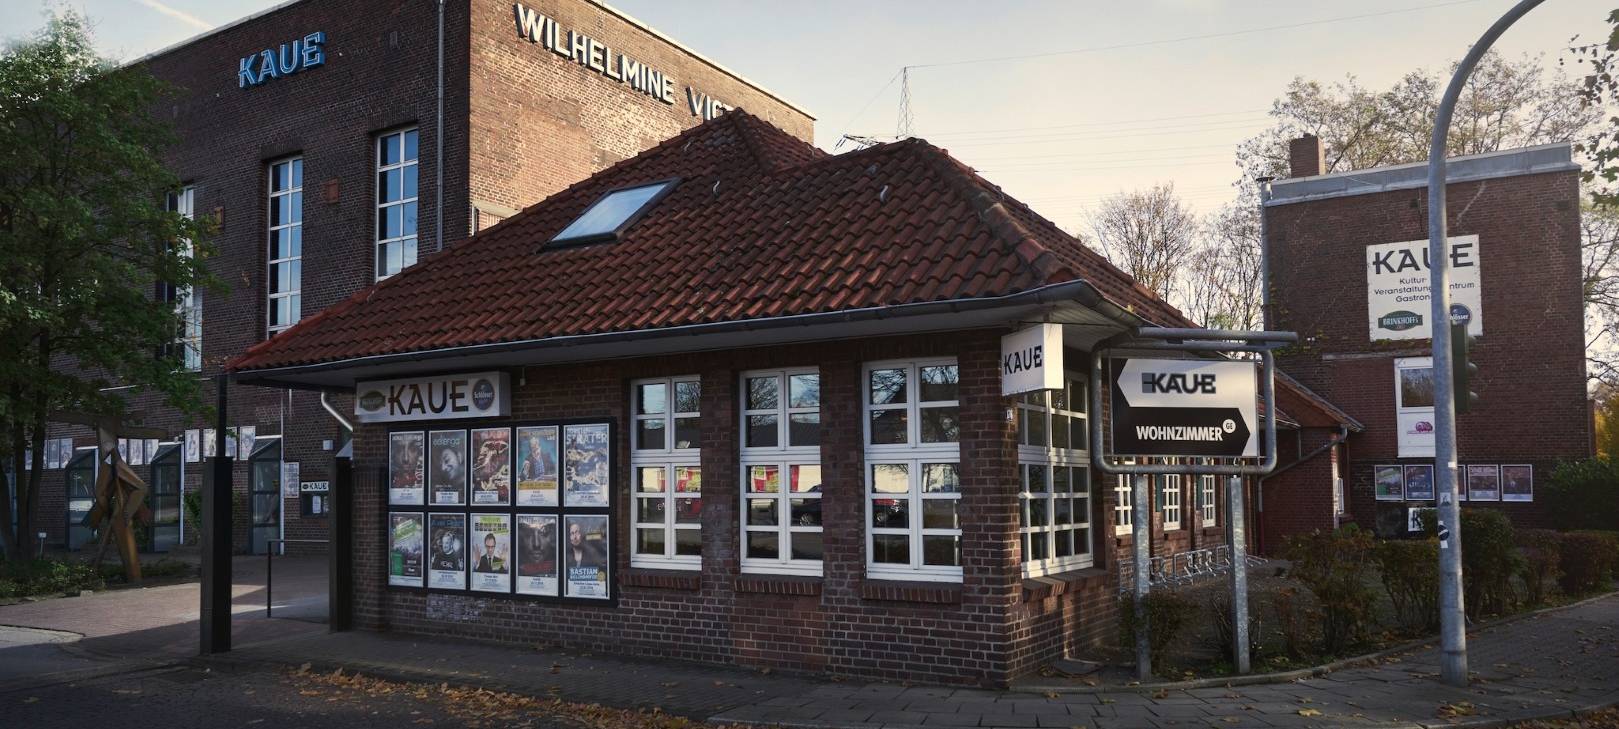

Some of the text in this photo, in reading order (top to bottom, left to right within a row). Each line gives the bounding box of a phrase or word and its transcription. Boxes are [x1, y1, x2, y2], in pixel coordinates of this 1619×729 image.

[238, 31, 326, 88] KAUE
[514, 2, 675, 105] WILHELMINE
[1003, 345, 1042, 375] KAUE
[388, 380, 469, 416] KAUE
[1149, 372, 1216, 394] KAUE
[1136, 425, 1223, 441] WOHNZIMMER
